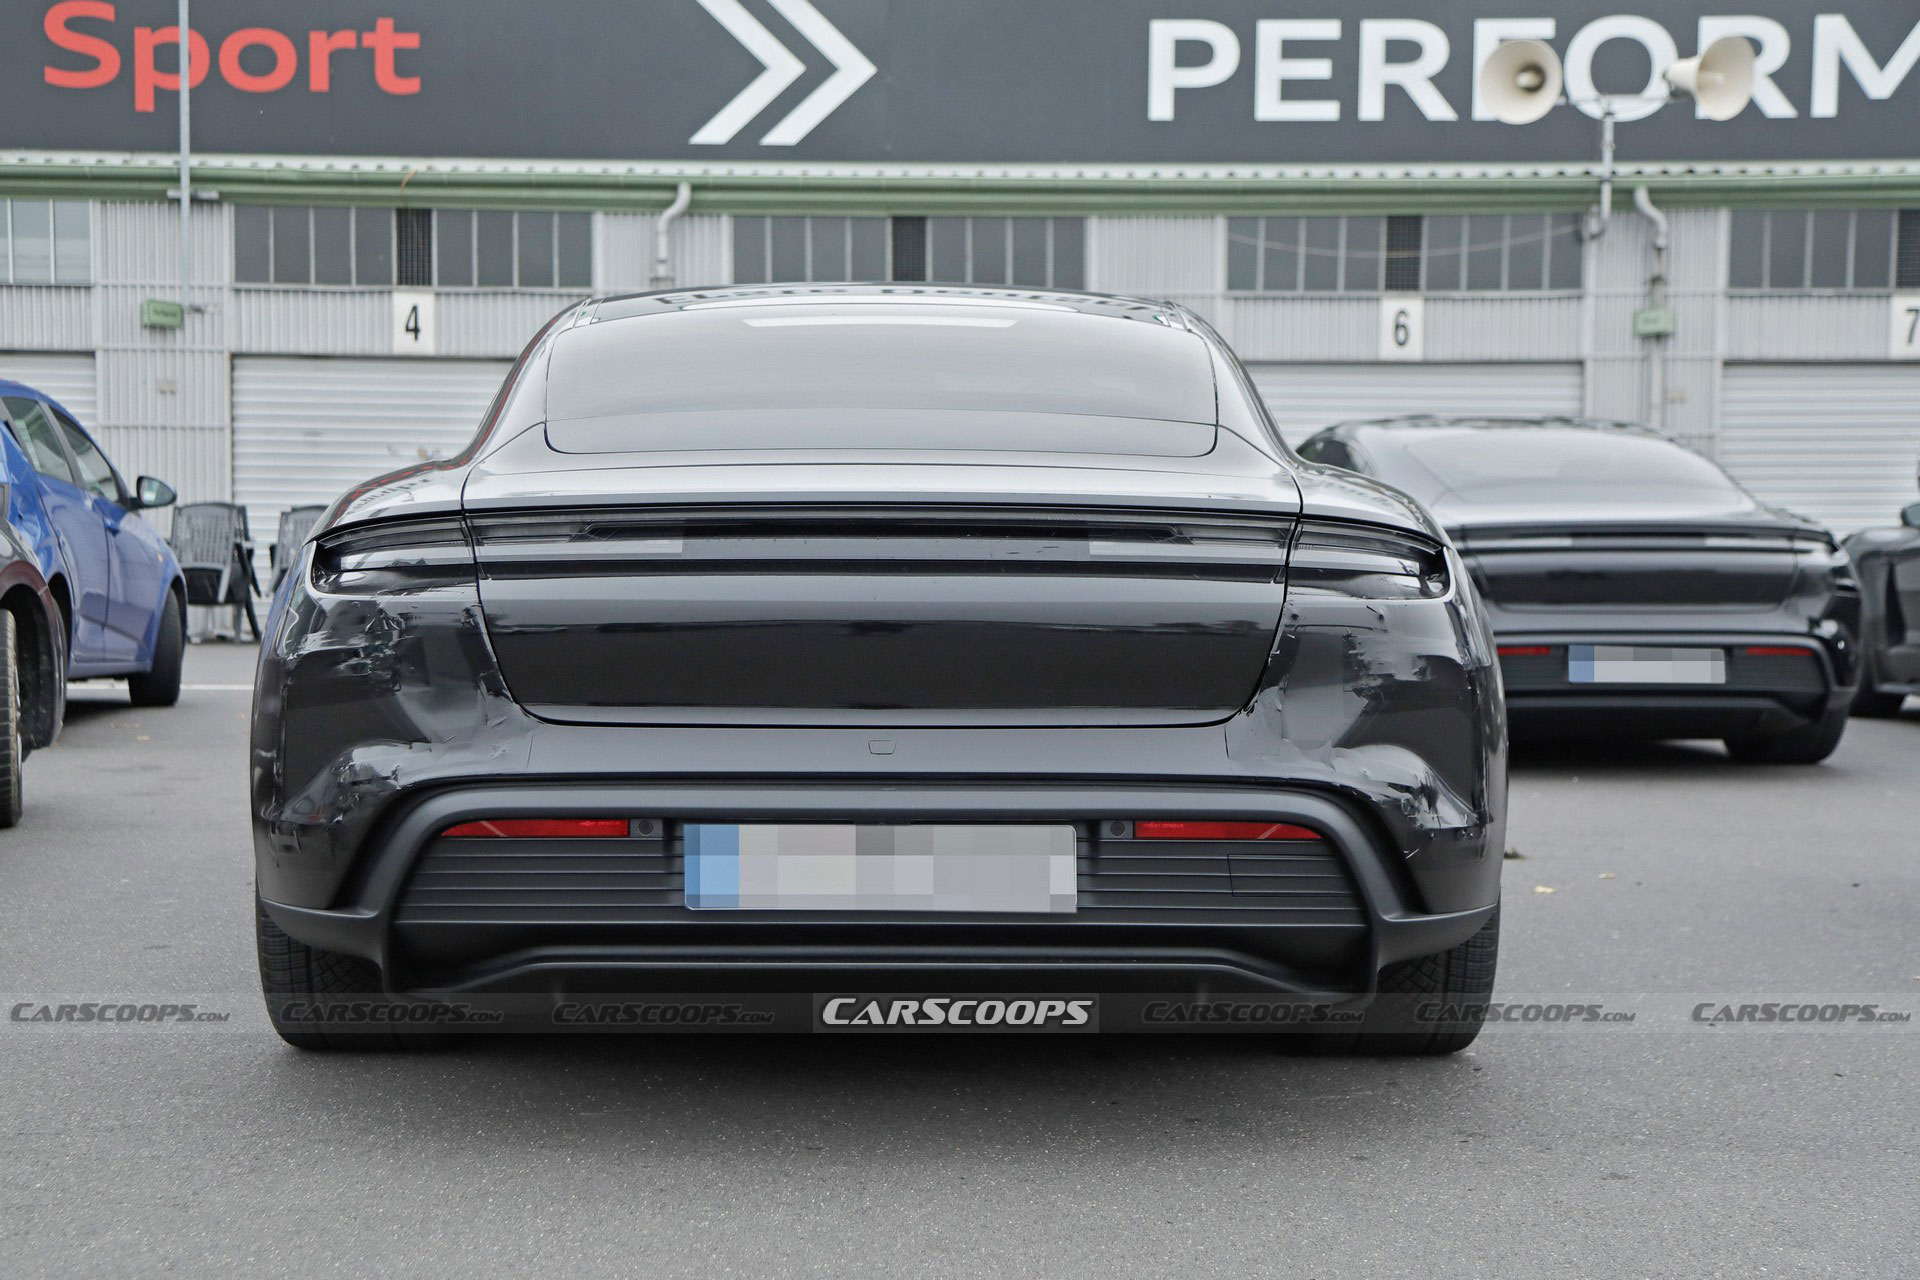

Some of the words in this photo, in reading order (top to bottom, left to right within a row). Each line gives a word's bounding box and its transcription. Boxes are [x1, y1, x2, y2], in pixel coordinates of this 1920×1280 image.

[43, 0, 422, 112] Sport
[405, 304, 421, 341] 4
[1394, 309, 1409, 347] 6
[1905, 307, 1920, 345] 7
